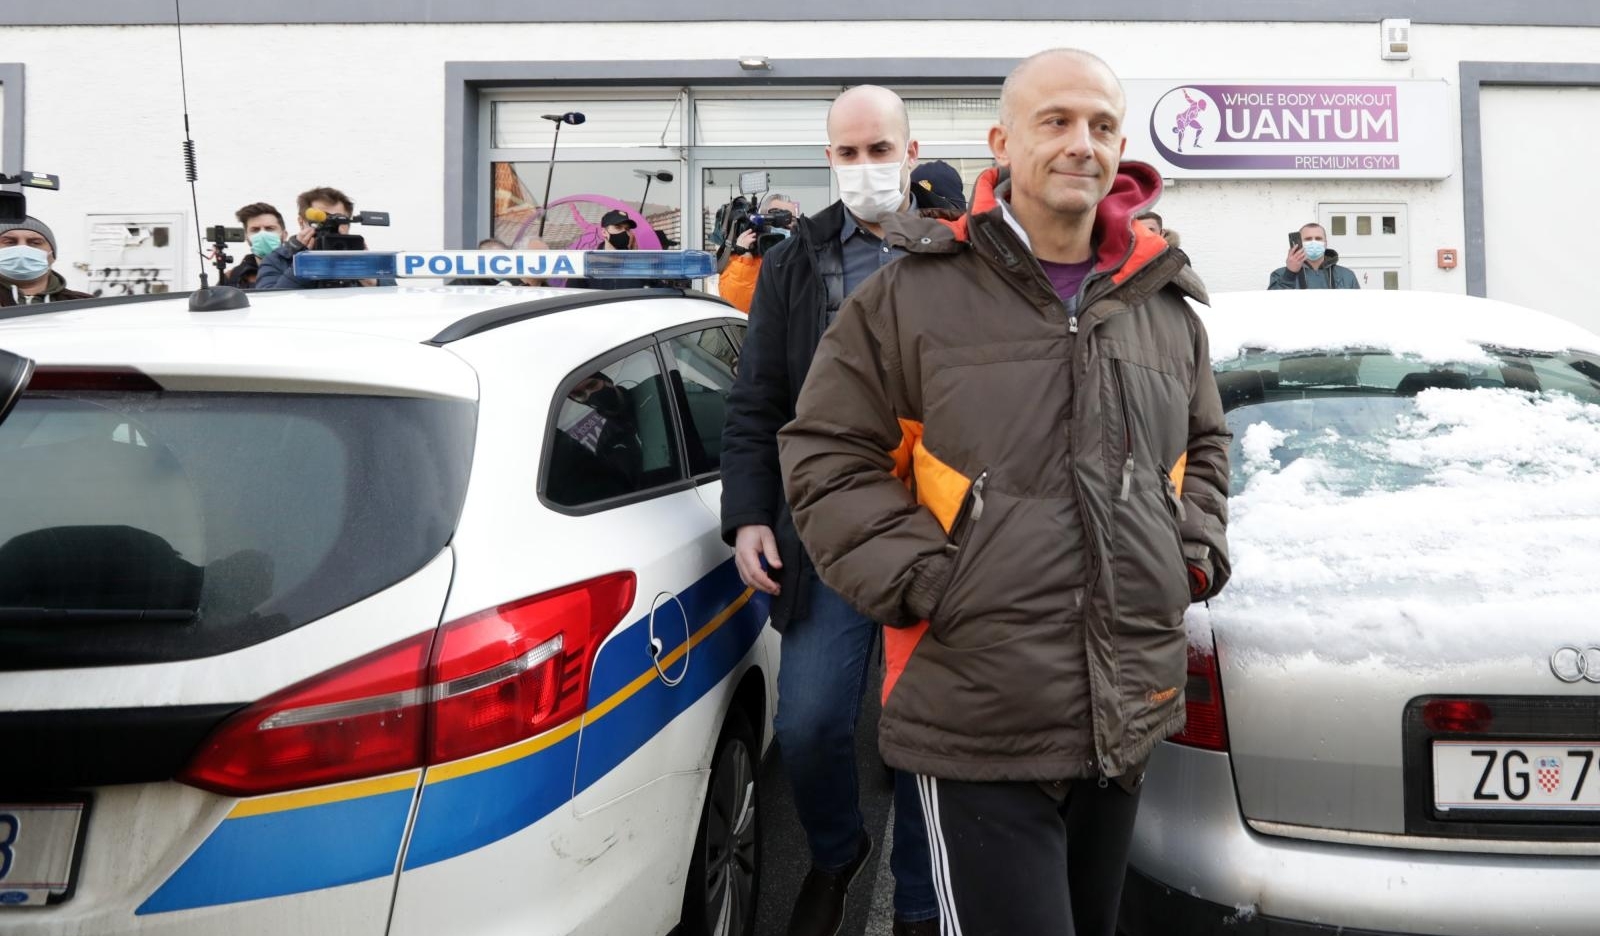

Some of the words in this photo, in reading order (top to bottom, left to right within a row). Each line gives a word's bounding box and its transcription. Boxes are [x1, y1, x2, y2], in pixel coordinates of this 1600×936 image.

[1221, 93, 1274, 106] WHOLE
[1278, 93, 1317, 106] BODY
[1320, 93, 1393, 106] WORKOUT
[1295, 156, 1359, 169] PREMIUM
[1363, 156, 1396, 169] GYM
[404, 255, 577, 276] POLICIJA
[1471, 749, 1531, 802] ZG
[1567, 749, 1600, 802] 7
